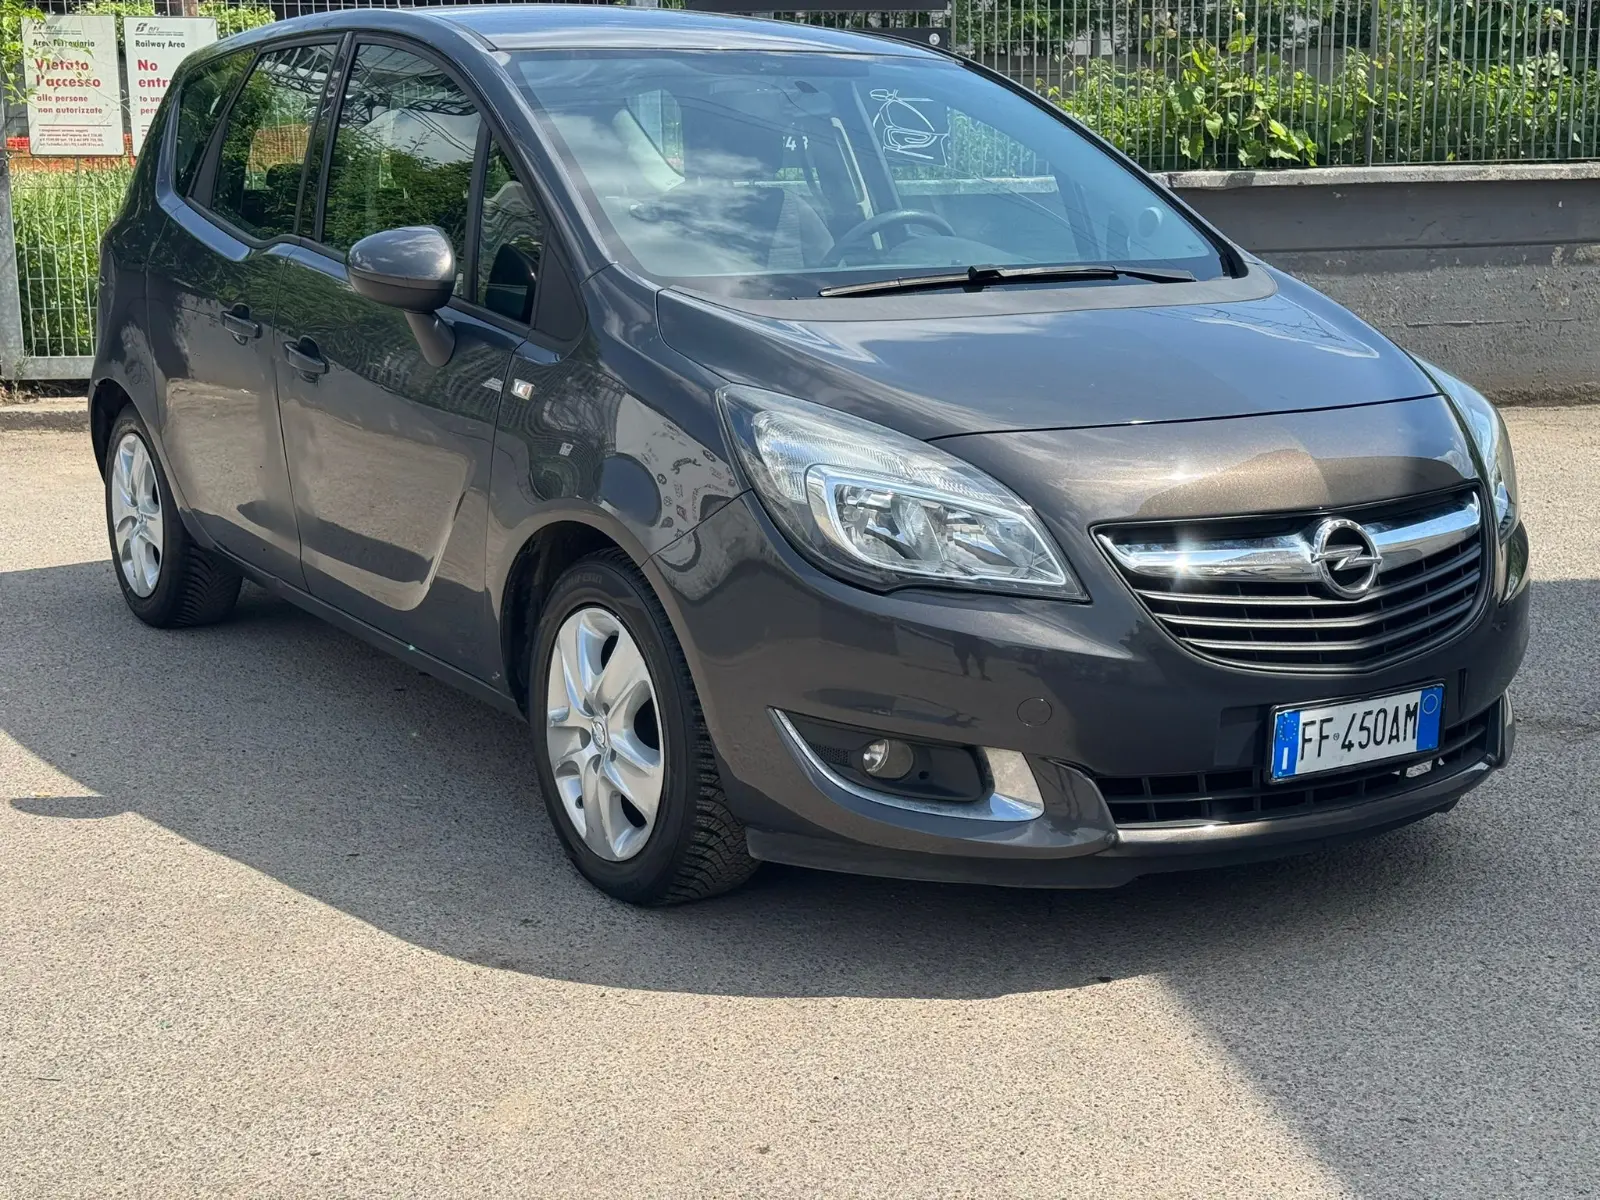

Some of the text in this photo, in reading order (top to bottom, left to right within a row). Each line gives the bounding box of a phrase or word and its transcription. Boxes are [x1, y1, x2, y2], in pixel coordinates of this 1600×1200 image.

[135, 40, 166, 49] Railway
[35, 58, 89, 71] Vietato
[137, 59, 158, 72] No
[36, 74, 101, 88] l'accesso
[37, 94, 88, 103] alle persone
[55, 106, 103, 114] autorizzate
[1300, 701, 1419, 761] FF 450AM
